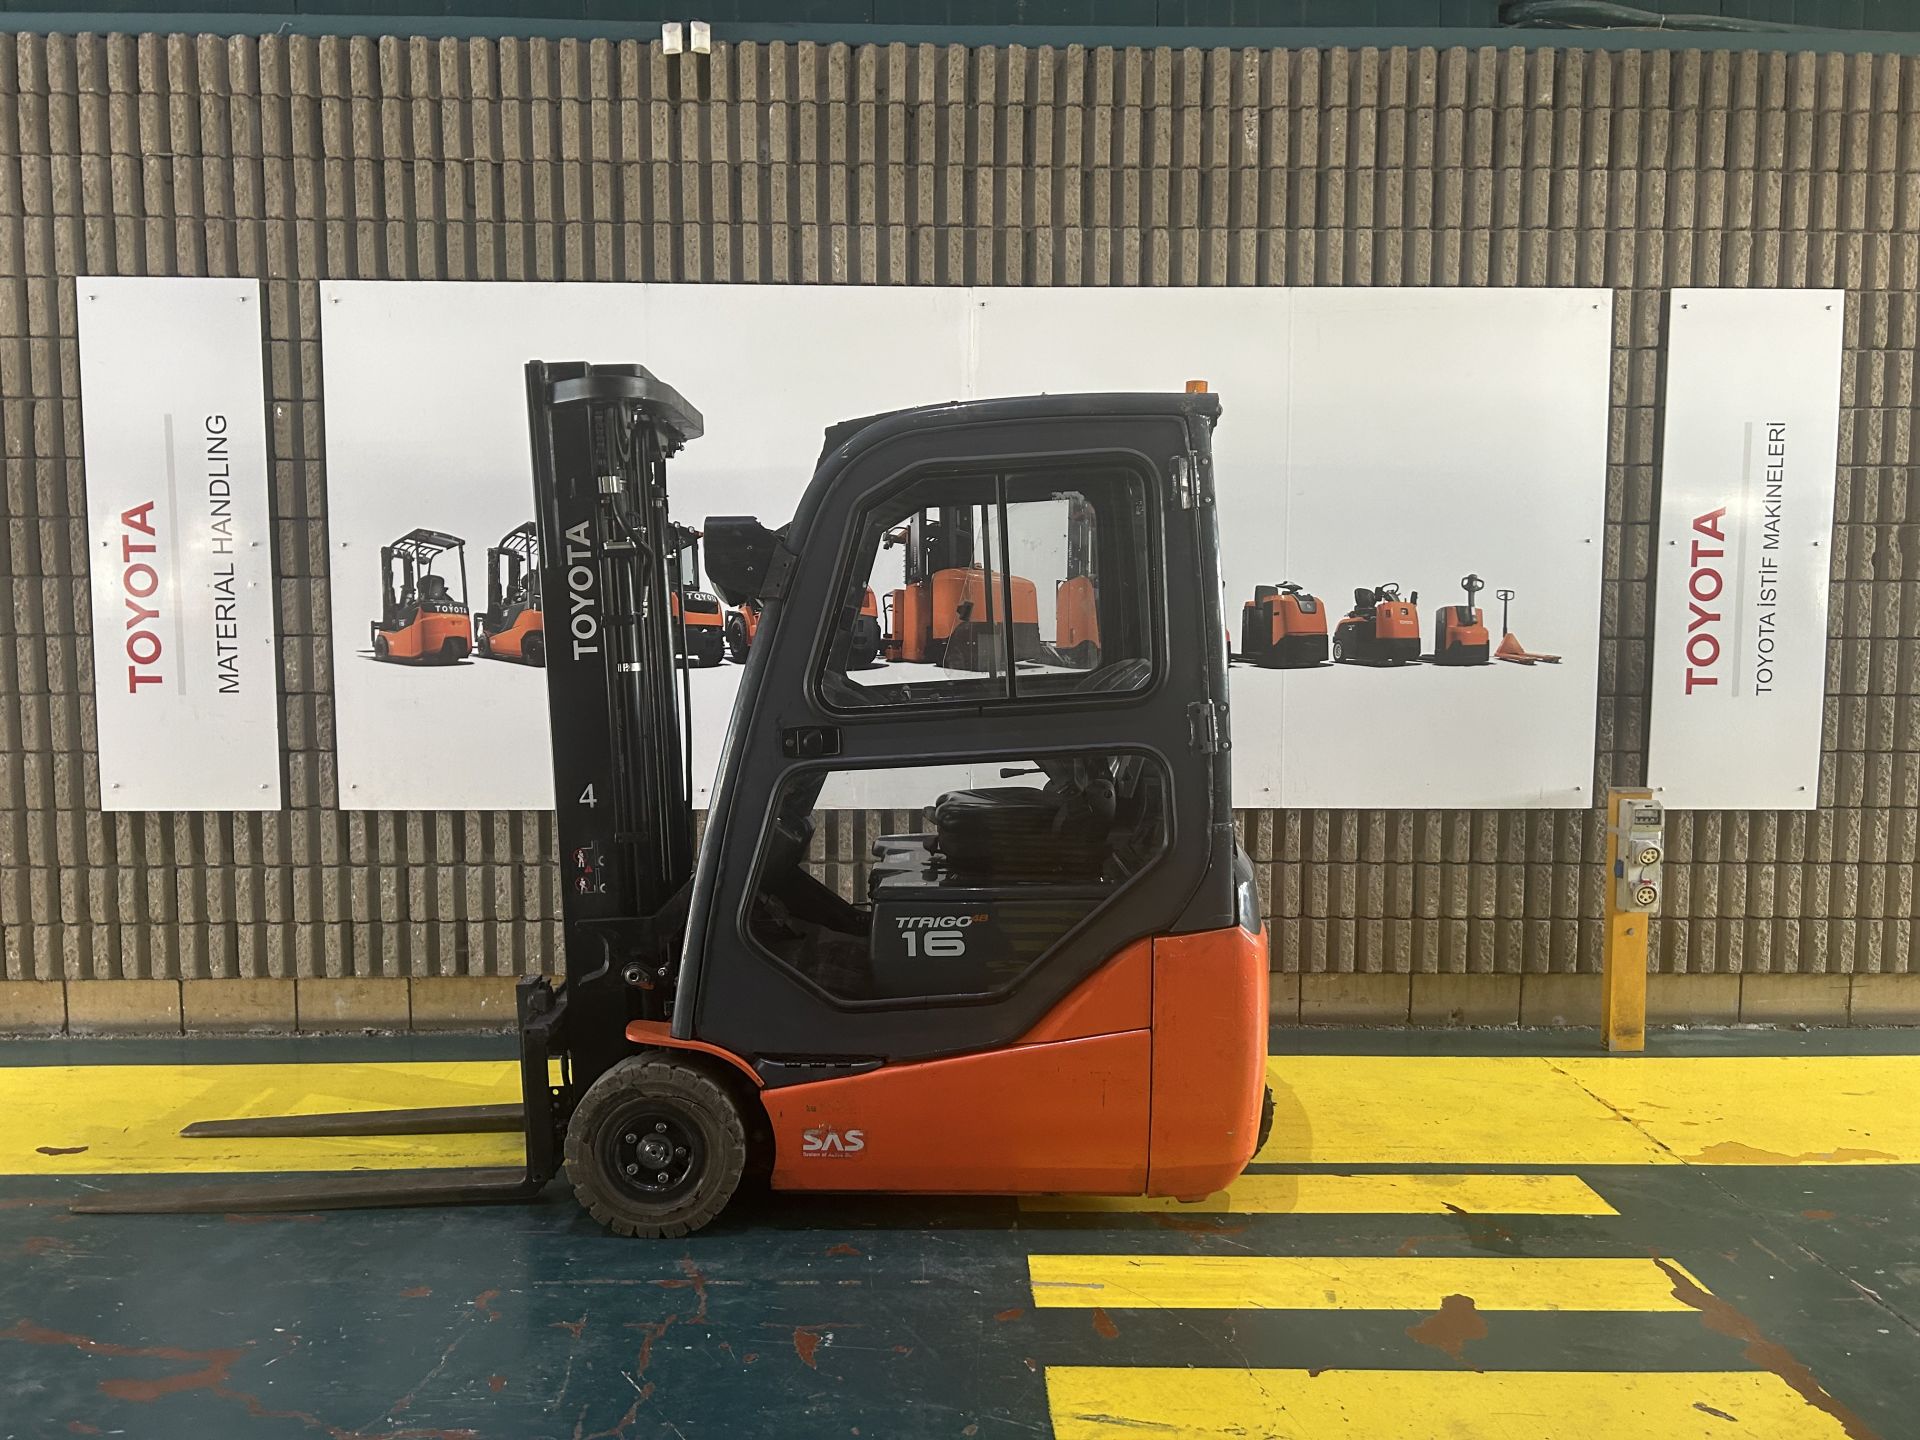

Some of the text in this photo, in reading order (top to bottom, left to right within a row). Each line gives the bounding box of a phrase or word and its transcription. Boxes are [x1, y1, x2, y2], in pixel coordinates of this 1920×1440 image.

[121, 501, 163, 694] TOYOTA
[205, 413, 240, 694] MATERIAL HANDLING
[434, 604, 468, 613] TOYOTA
[565, 520, 598, 661] TOYOTA
[1684, 507, 1726, 695] TOYOTA
[1755, 421, 1786, 696] TOYOTA İSTİF MAKİNELERİ
[579, 783, 598, 808] 4
[901, 930, 966, 957] 16
[802, 1129, 864, 1151] SAS
